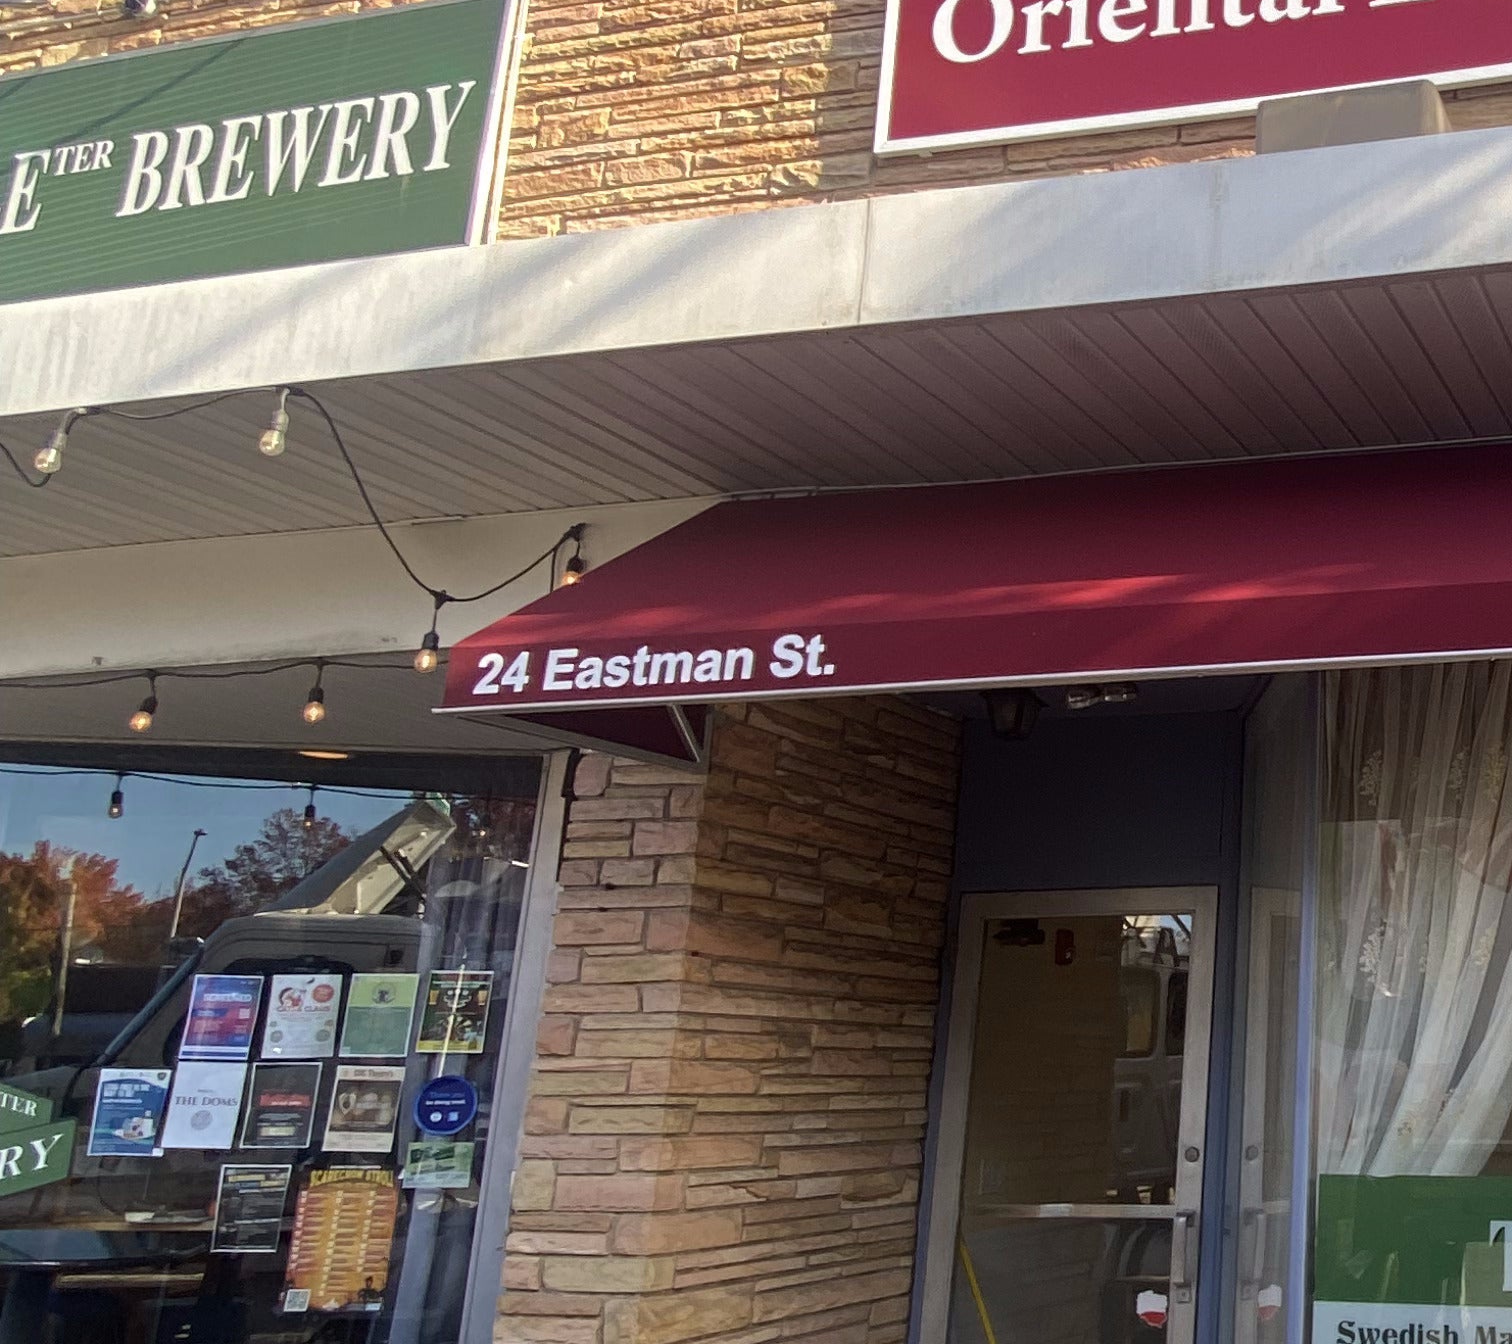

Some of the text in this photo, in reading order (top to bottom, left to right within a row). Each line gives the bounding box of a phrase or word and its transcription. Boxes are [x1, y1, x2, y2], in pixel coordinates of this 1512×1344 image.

[116, 81, 477, 218] BREWERY
[472, 634, 835, 695] 24 Eastman St.
